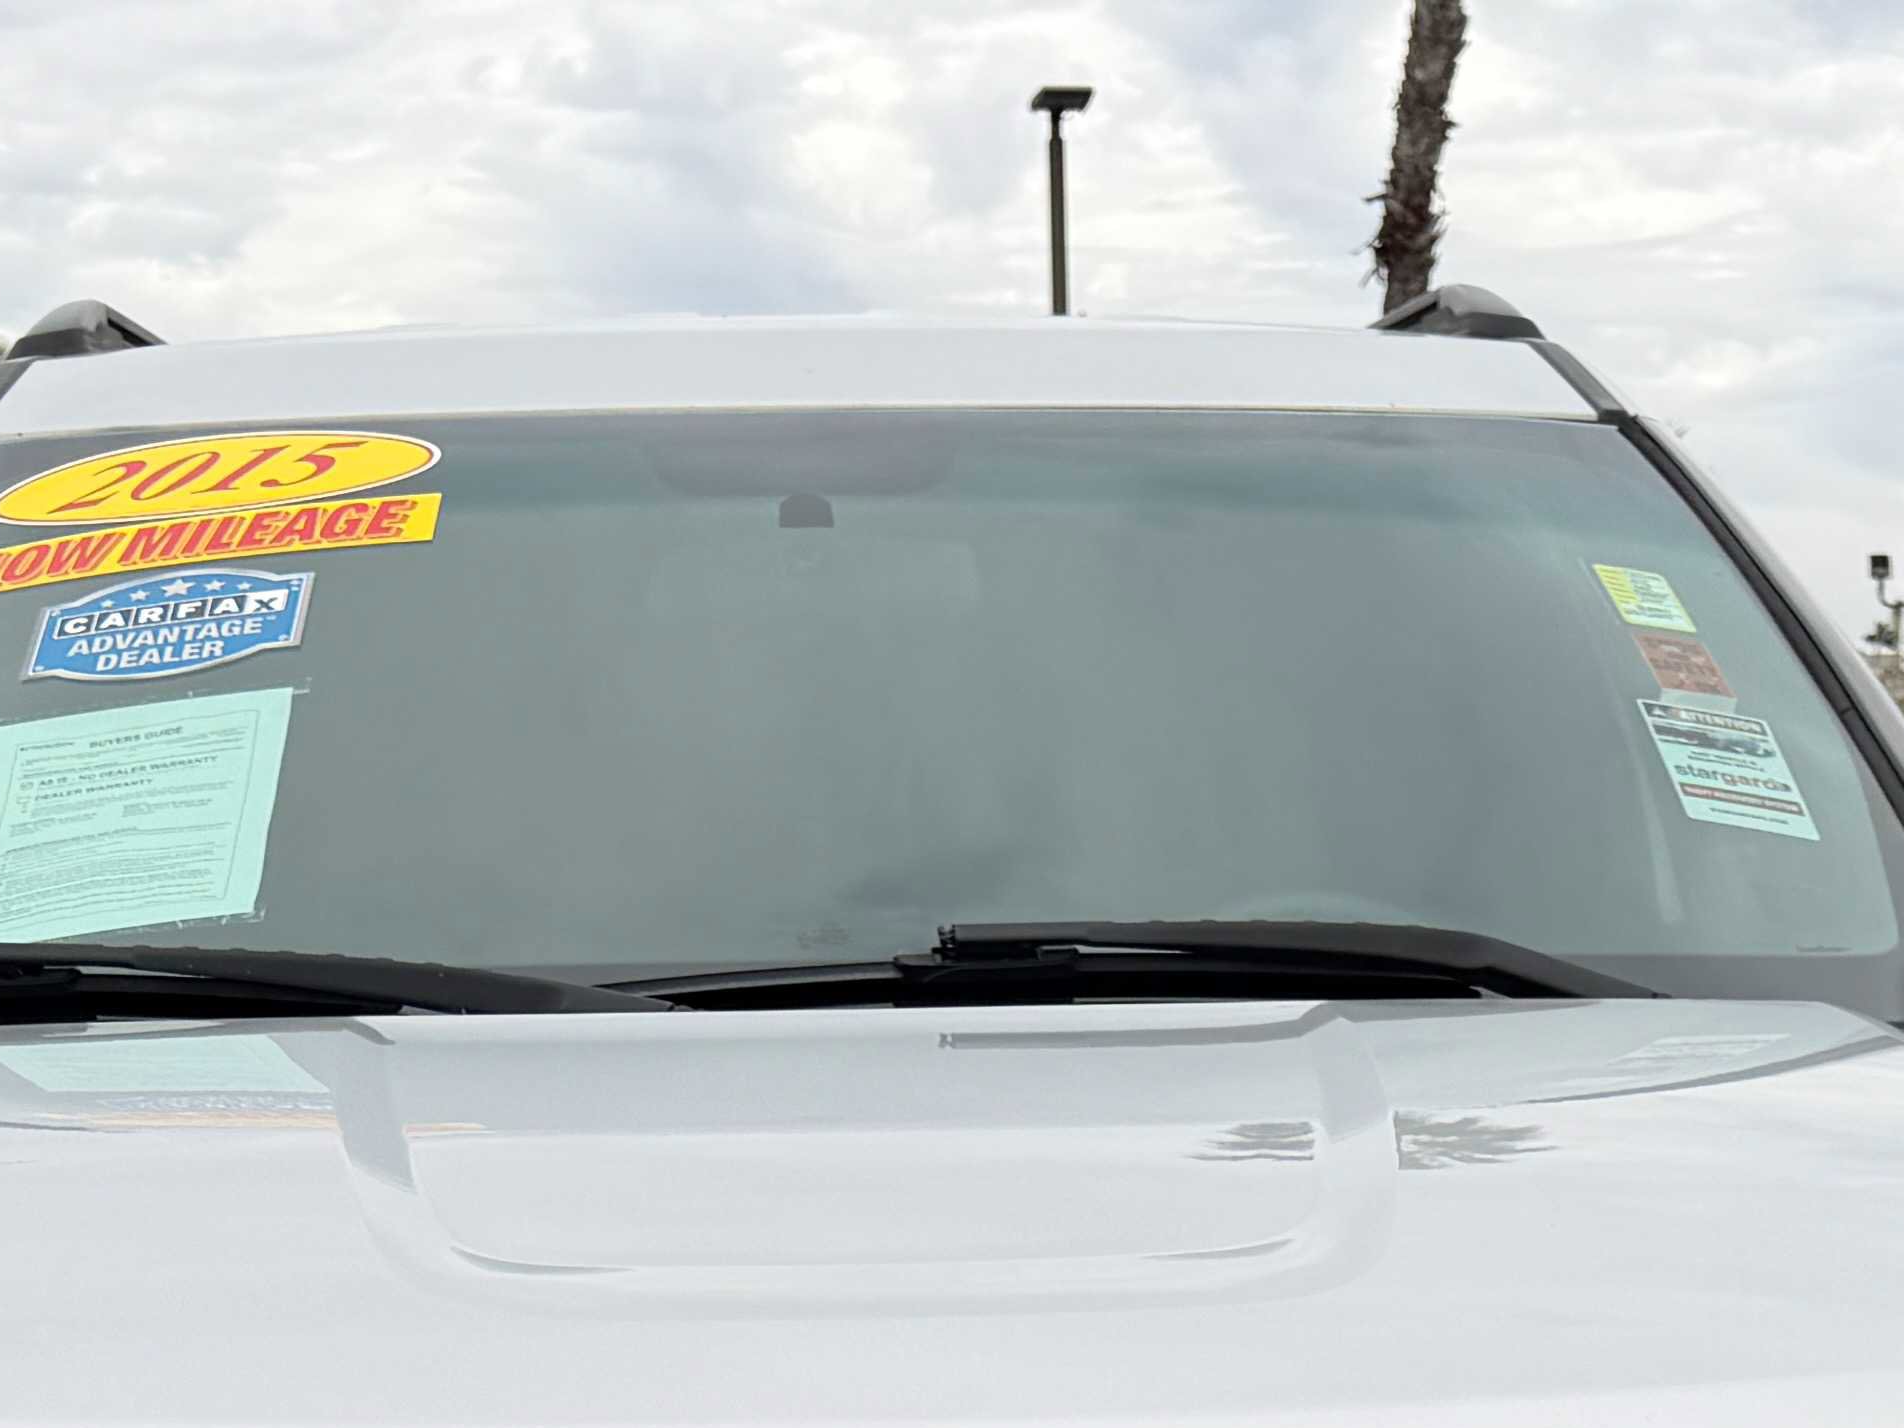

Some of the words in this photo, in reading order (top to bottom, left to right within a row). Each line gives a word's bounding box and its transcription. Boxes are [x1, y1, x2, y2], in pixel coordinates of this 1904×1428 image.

[48, 441, 370, 514] 2015
[118, 499, 420, 566] MILEAGE
[63, 595, 280, 635] CARFAX
[66, 617, 264, 657] ADVANTAGE
[96, 640, 225, 672] DEALER
[89, 734, 141, 749] BUYERS
[144, 726, 184, 741] GUIDE
[99, 764, 147, 779] DEALER
[150, 754, 219, 771] WARRANTY
[34, 787, 83, 801] DEALER
[86, 778, 154, 795] WARRANTY
